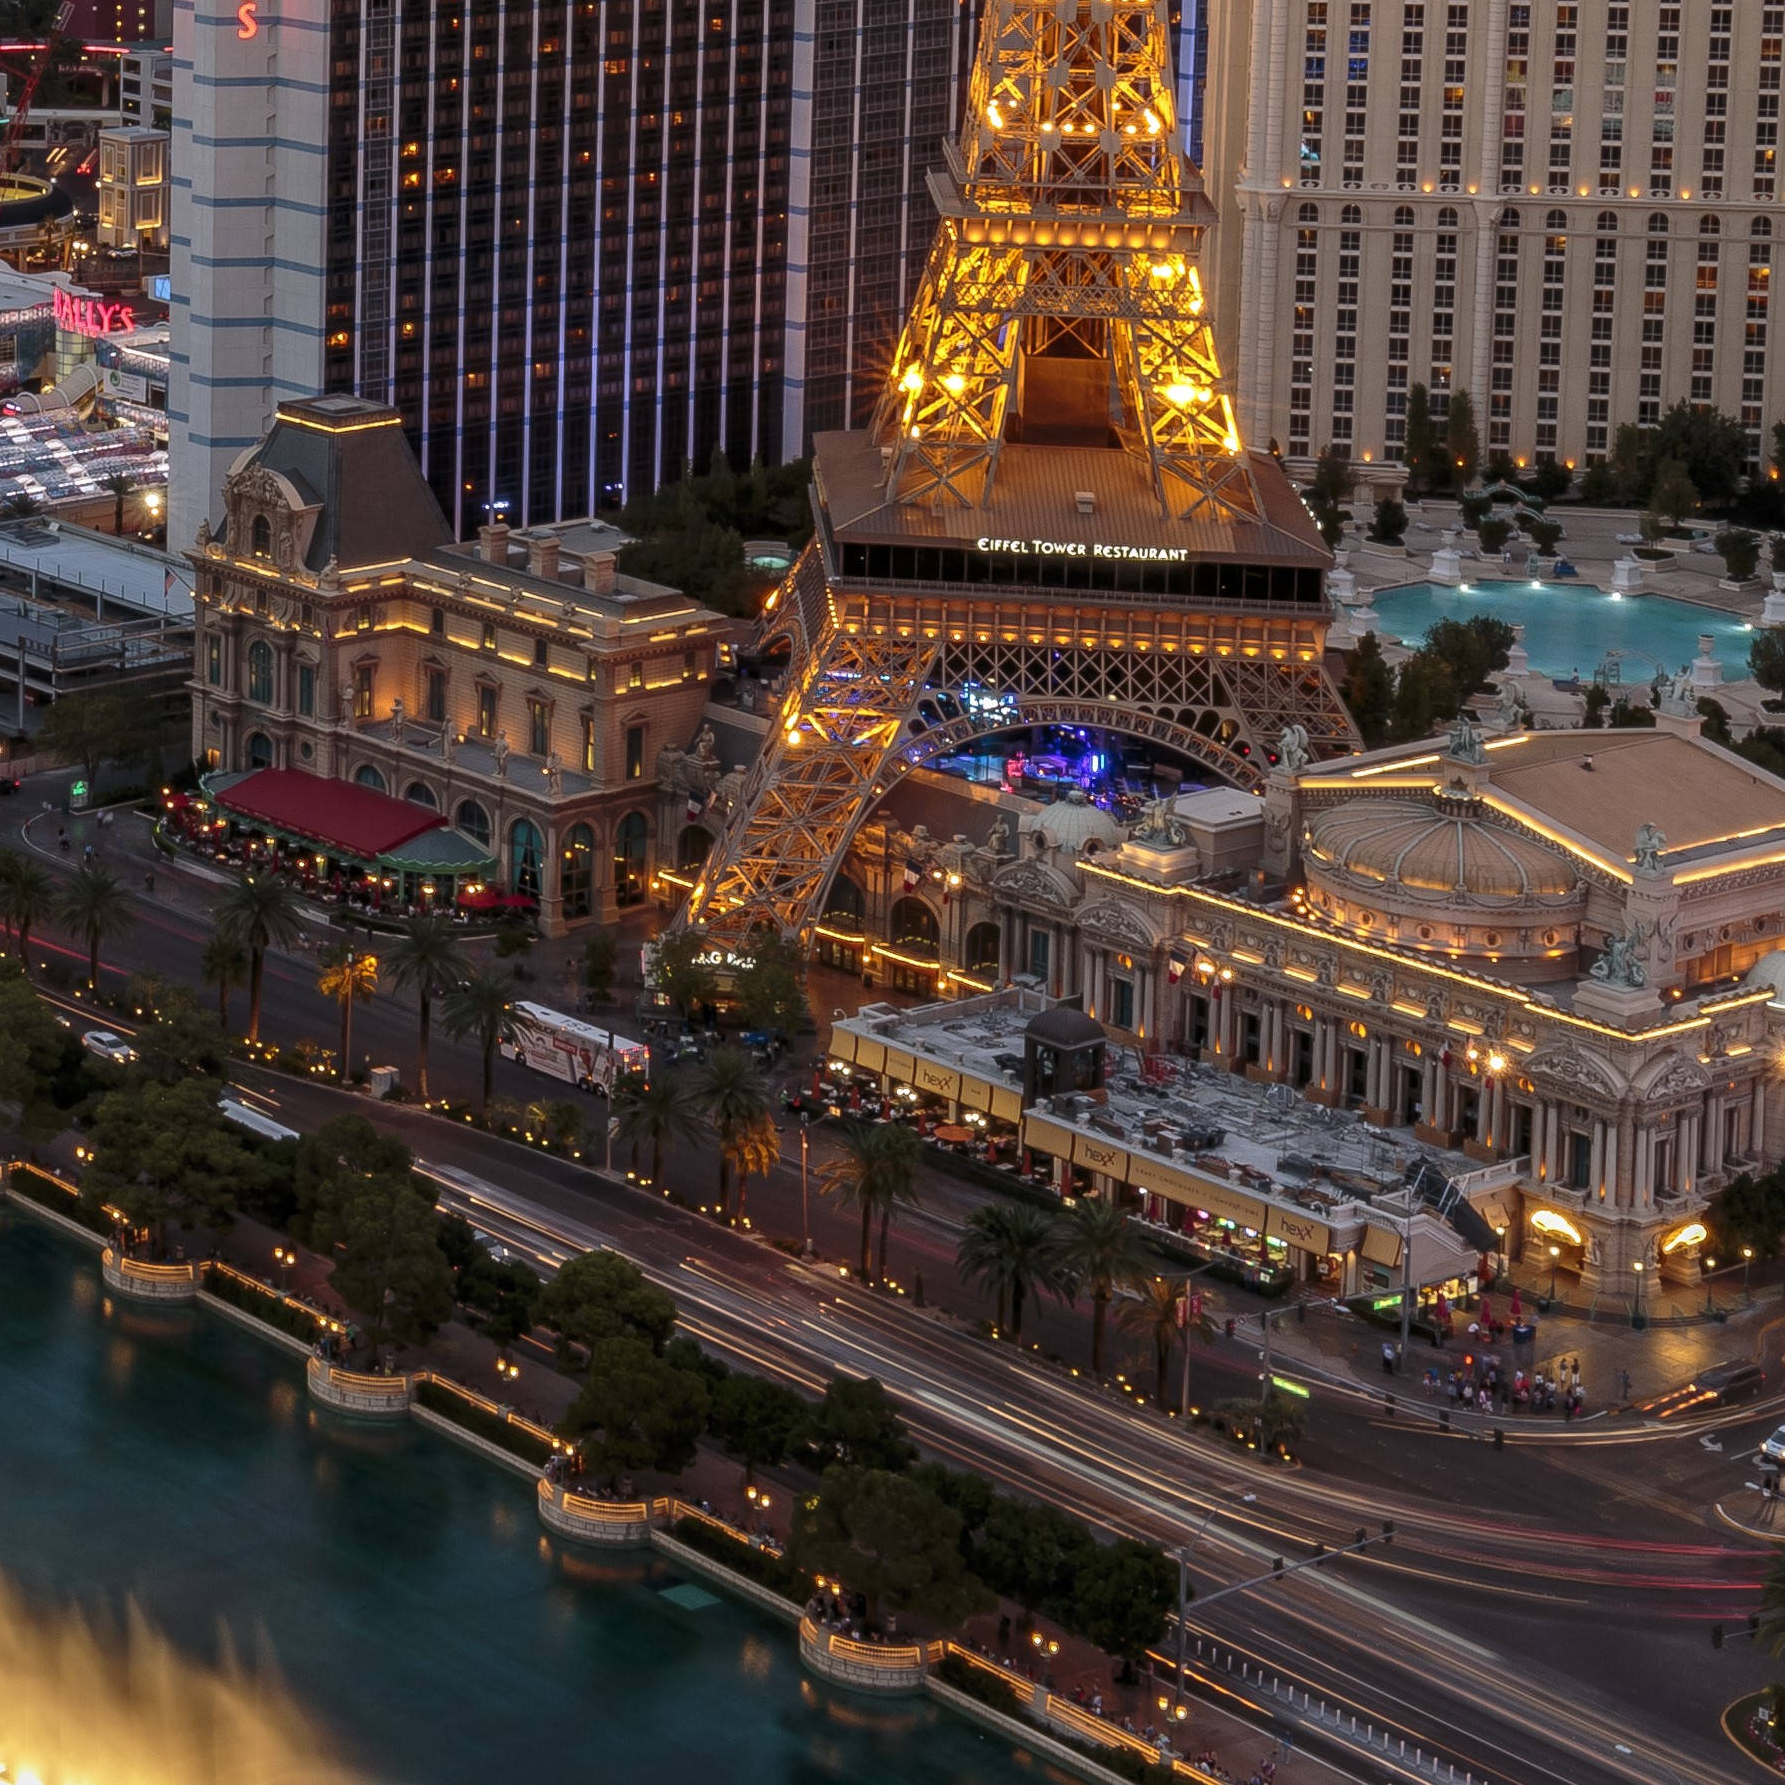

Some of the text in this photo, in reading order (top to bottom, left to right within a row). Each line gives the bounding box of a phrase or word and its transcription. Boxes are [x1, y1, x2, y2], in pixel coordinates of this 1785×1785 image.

[53, 287, 136, 333] BALLY'S
[977, 537, 1189, 562] EIFFEL TOWER RESTAURANT
